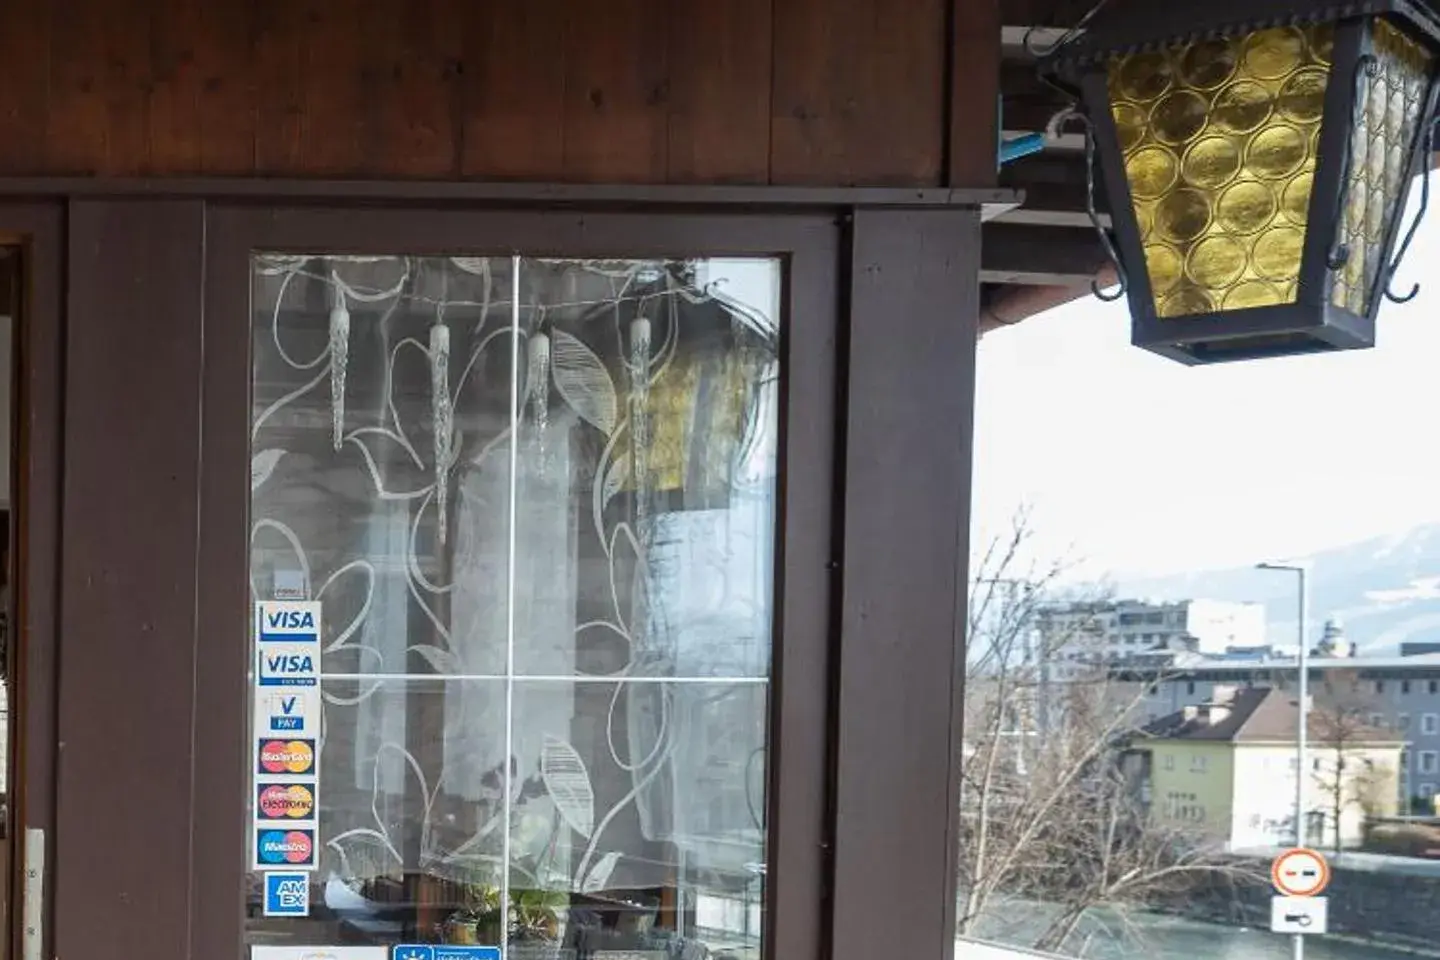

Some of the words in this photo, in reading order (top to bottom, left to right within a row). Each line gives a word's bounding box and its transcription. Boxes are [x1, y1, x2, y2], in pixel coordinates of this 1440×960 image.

[268, 611, 314, 628] VISA
[268, 655, 314, 672] VISA
[275, 719, 298, 729] PAY
[280, 880, 306, 894] AM
[283, 893, 304, 907] EX
